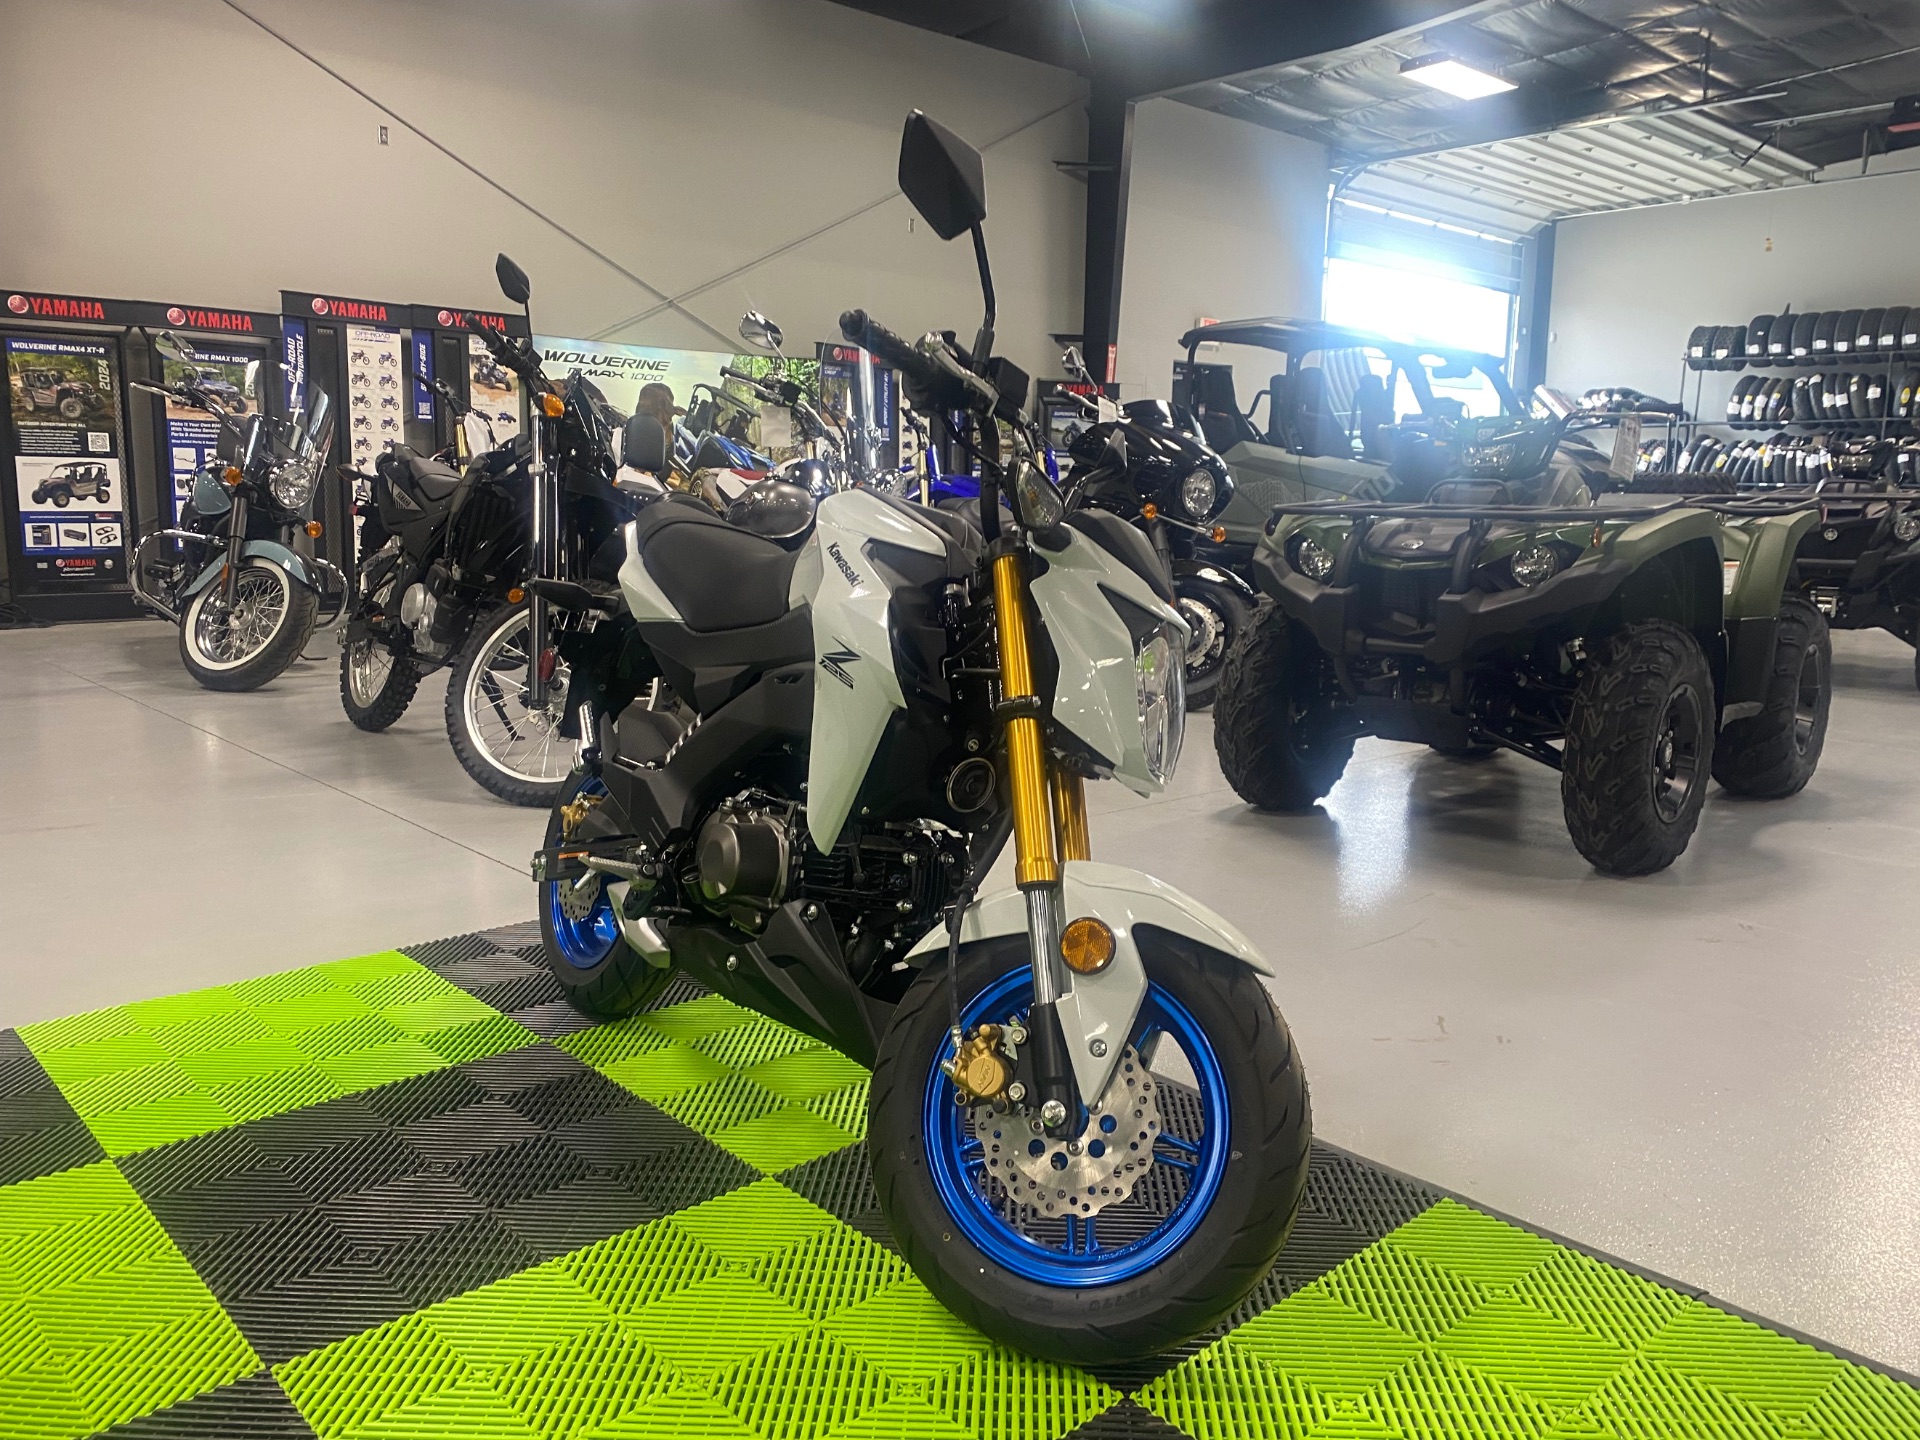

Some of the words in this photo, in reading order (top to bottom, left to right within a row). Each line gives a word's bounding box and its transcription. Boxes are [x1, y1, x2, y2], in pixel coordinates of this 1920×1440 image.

[30, 297, 105, 320] YAMAHA
[329, 300, 387, 321] YAMAHA
[187, 310, 253, 331] YAMAHA
[453, 312, 506, 332] YAHA
[11, 341, 57, 351] WOLVERINE
[58, 344, 86, 353] RMAX4
[86, 346, 105, 354] XT-R
[210, 354, 231, 362] RMAX
[844, 349, 881, 364] YAMHA
[287, 336, 296, 383] OFF-ROAD
[419, 342, 427, 392] SIE-BY-SIDE
[544, 349, 671, 371] WOLVERINE
[97, 359, 111, 391] 2024
[630, 372, 664, 382] 1000
[1066, 384, 1104, 396] YAMAA
[826, 541, 865, 588] Kawasaki
